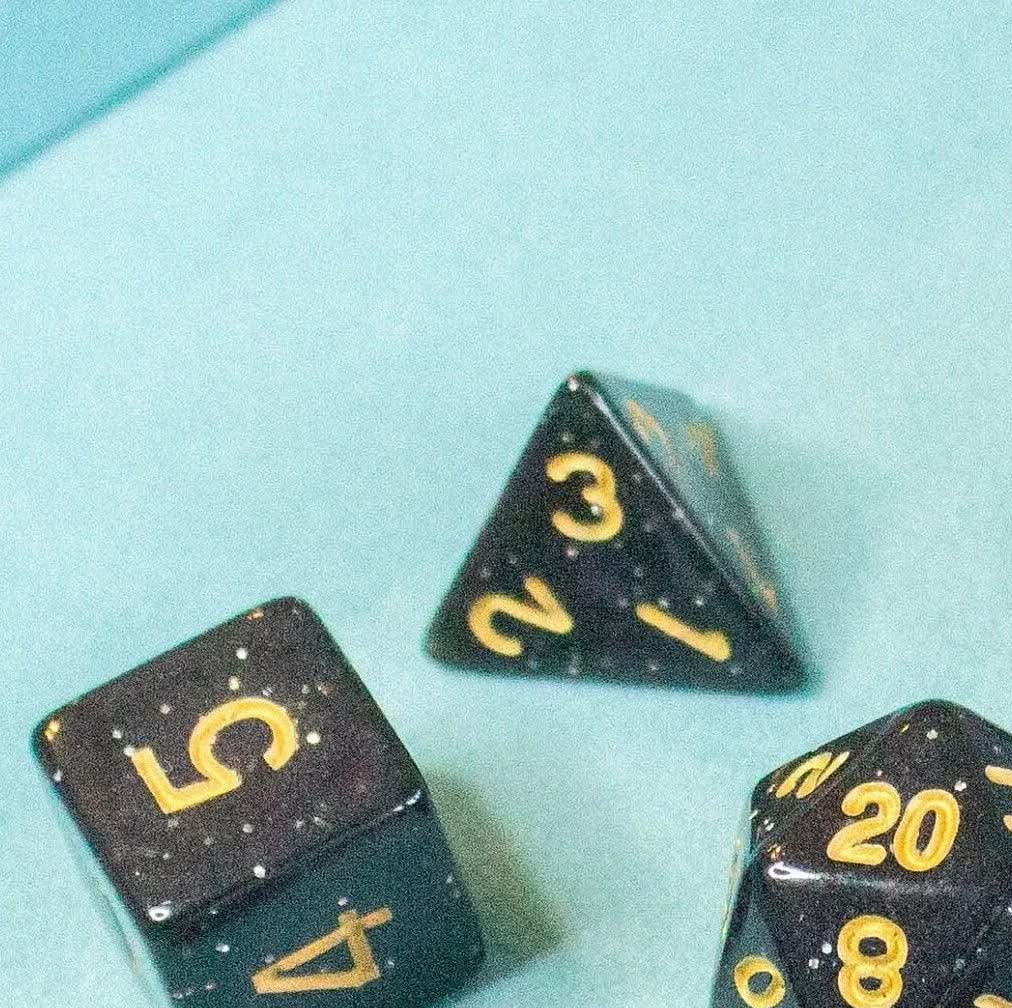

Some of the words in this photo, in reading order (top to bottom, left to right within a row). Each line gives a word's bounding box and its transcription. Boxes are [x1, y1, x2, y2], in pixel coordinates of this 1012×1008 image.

[545, 451, 625, 543] 3
[468, 575, 575, 658] 2
[636, 602, 732, 664] 1
[130, 697, 302, 816] 5
[826, 780, 962, 874] 20
[250, 906, 393, 995] 4
